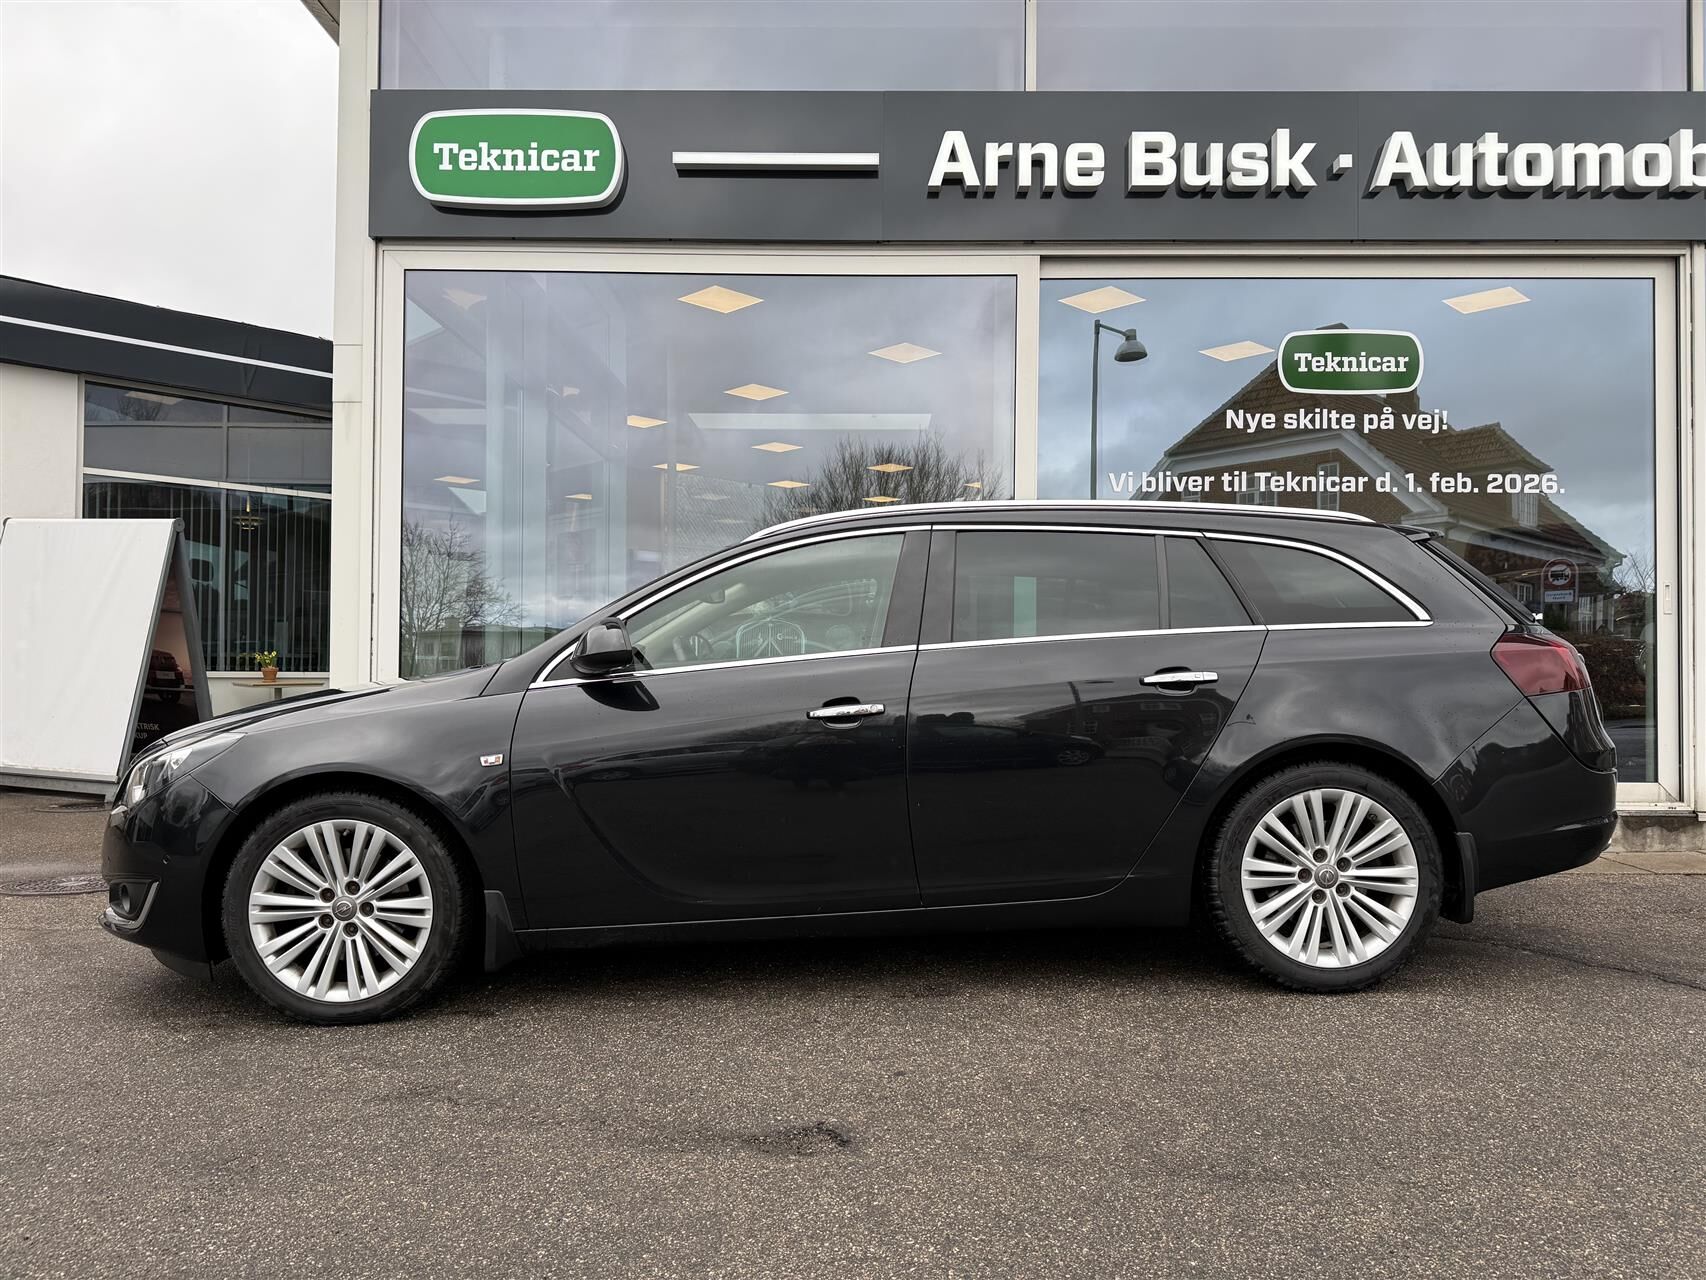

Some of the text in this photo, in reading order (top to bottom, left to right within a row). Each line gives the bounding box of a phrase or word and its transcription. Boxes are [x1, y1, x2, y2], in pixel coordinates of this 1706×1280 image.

[433, 141, 601, 173] Teknicar
[927, 130, 1105, 188] Arne
[1130, 128, 1318, 188] Busk
[1374, 129, 1706, 188] Automob
[1293, 351, 1409, 373] Teknicar
[1226, 406, 1449, 434] Nye skilte på vej!
[1109, 471, 1566, 495] Vi bliver til Teknicar d. 1. feb. 2026.
